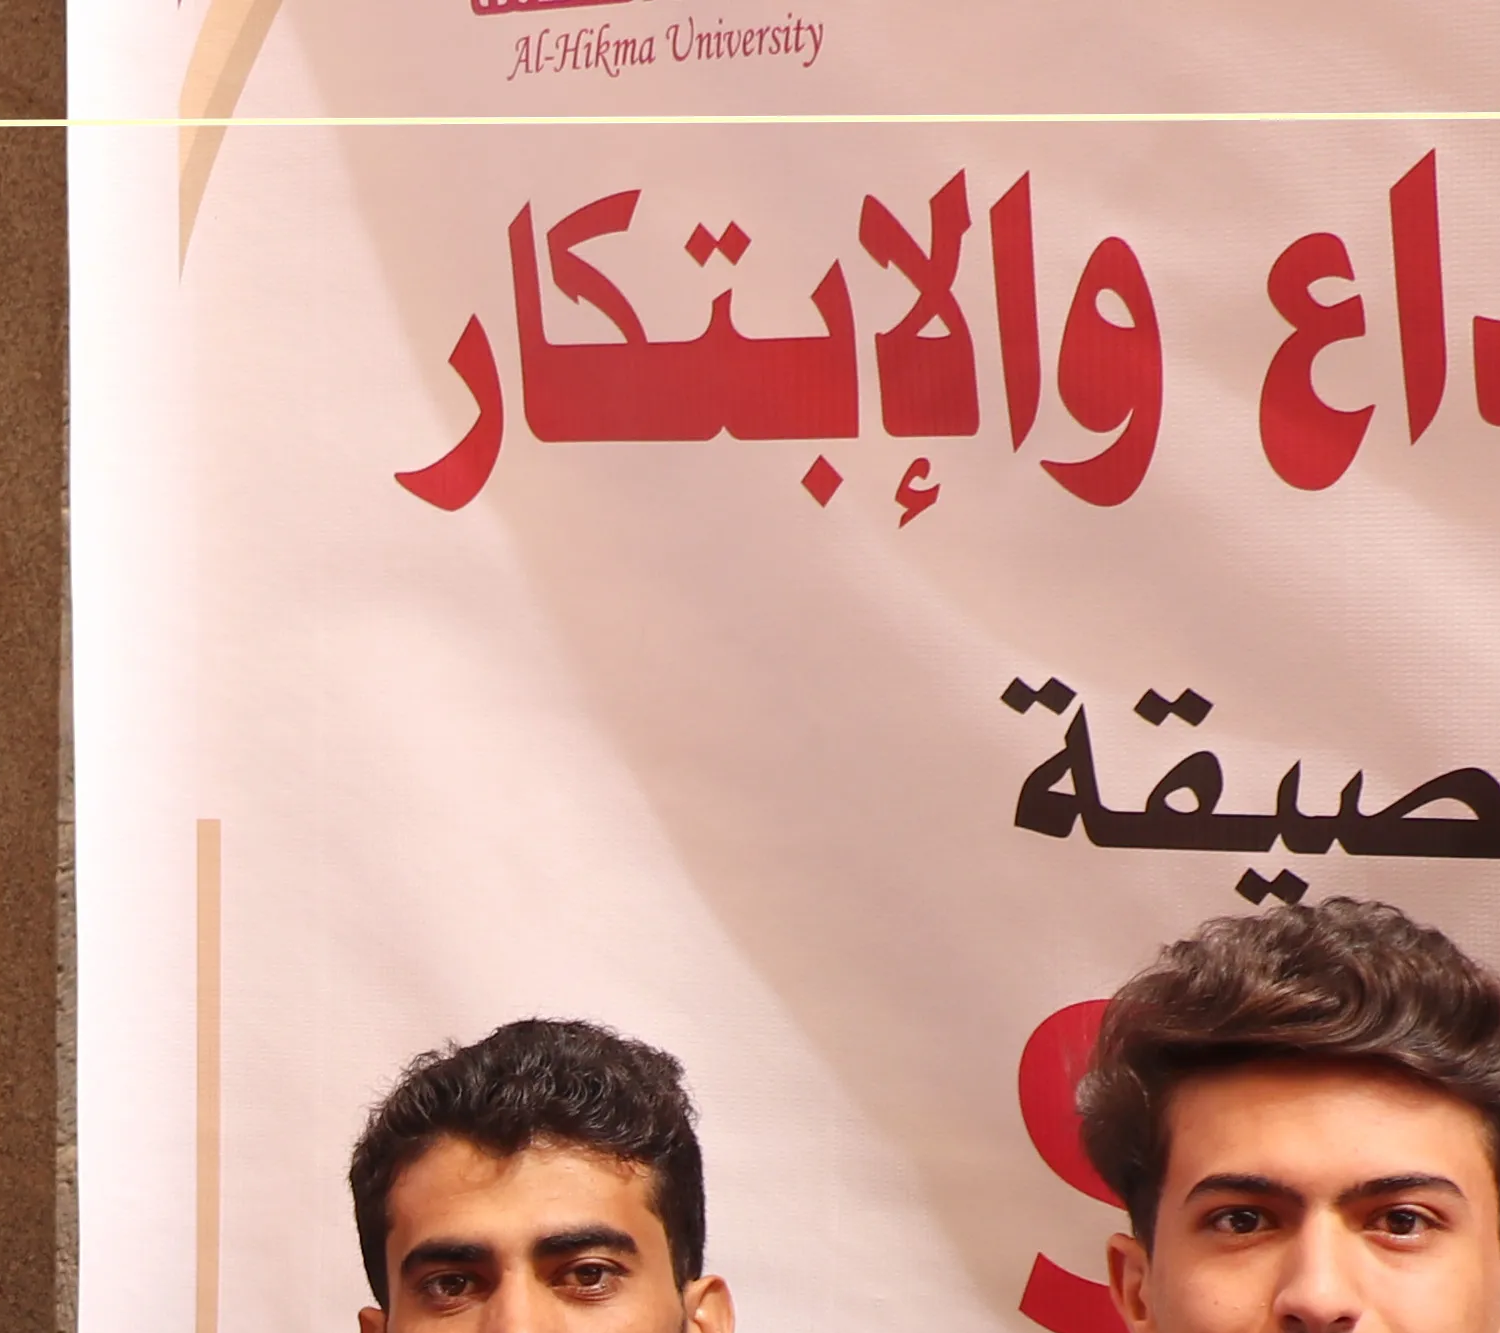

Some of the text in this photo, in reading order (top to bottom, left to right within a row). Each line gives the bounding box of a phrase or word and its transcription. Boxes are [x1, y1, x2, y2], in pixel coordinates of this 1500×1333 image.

[507, 12, 824, 81] Al-Hikma University
[394, 167, 1165, 529] والإبتكار
